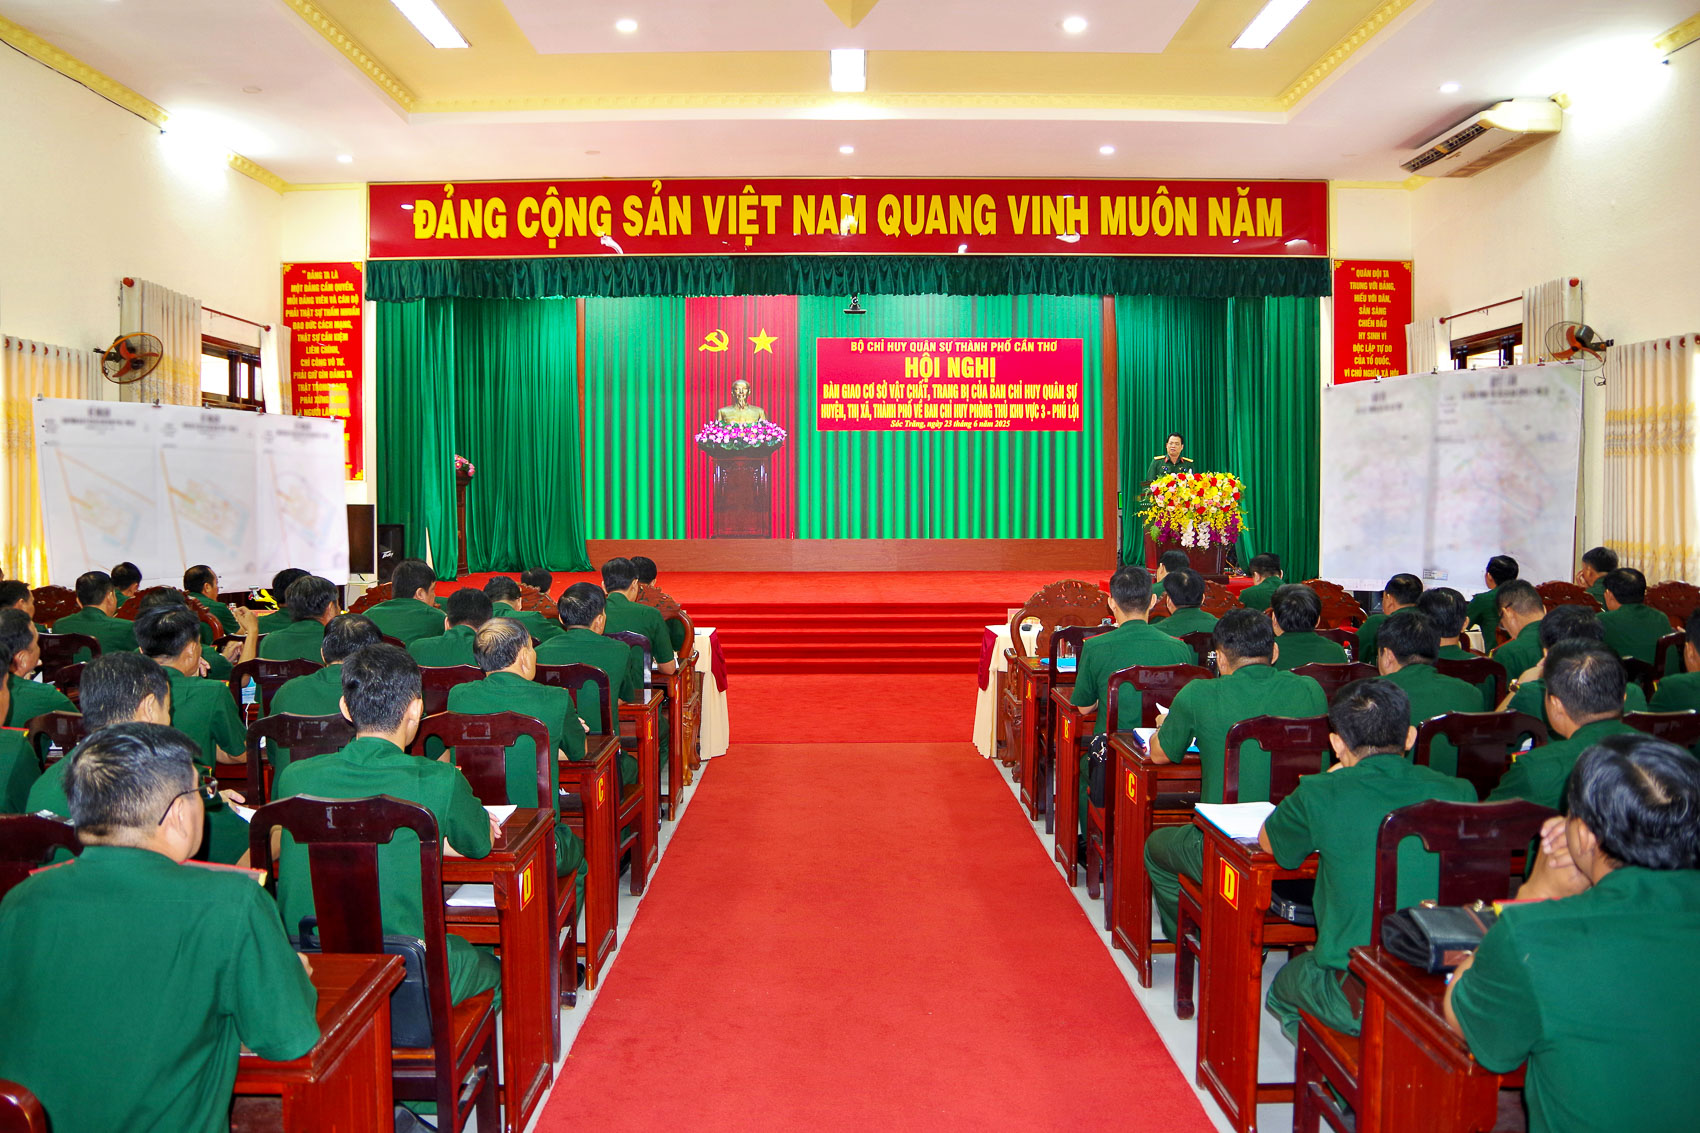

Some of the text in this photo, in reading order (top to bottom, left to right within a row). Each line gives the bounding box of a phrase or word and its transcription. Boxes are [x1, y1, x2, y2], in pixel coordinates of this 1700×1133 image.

[413, 180, 1283, 249] ĐẢNG CỘNG SẢN VIỆT NAM QUANG VINH MUÔN NĂM
[851, 338, 1058, 354] BỘ CHỈ HUY QUÂN SỰ THÀNH PHỐ CẦN THƠ
[905, 352, 996, 383] HỘI NGHỊ
[823, 379, 1078, 402] BÀN GIAO CƠ SỞ VẬT CHẤT, TRANG BỊ CỦA BAN CHỈ HUY QUÂN SỰ
[847, 404, 859, 421] THỊ
[873, 400, 896, 418] THÀNH
[898, 399, 912, 418] PHỐ
[914, 399, 922, 418] VỀ
[924, 404, 938, 418] BAN
[940, 400, 952, 418] CHỈ
[954, 404, 968, 418] HUY
[969, 400, 992, 418] PHÒNG
[994, 400, 1008, 418] THỦ
[1010, 404, 1023, 418] KHU
[1025, 402, 1039, 421] VỰC
[1041, 404, 1045, 418] 3
[1052, 401, 1066, 418] PHÚ
[1068, 402, 1079, 422] LỢI
[598, 778, 603, 800] C
[1128, 773, 1136, 798] C
[524, 869, 531, 902] D
[1224, 864, 1235, 900] D
